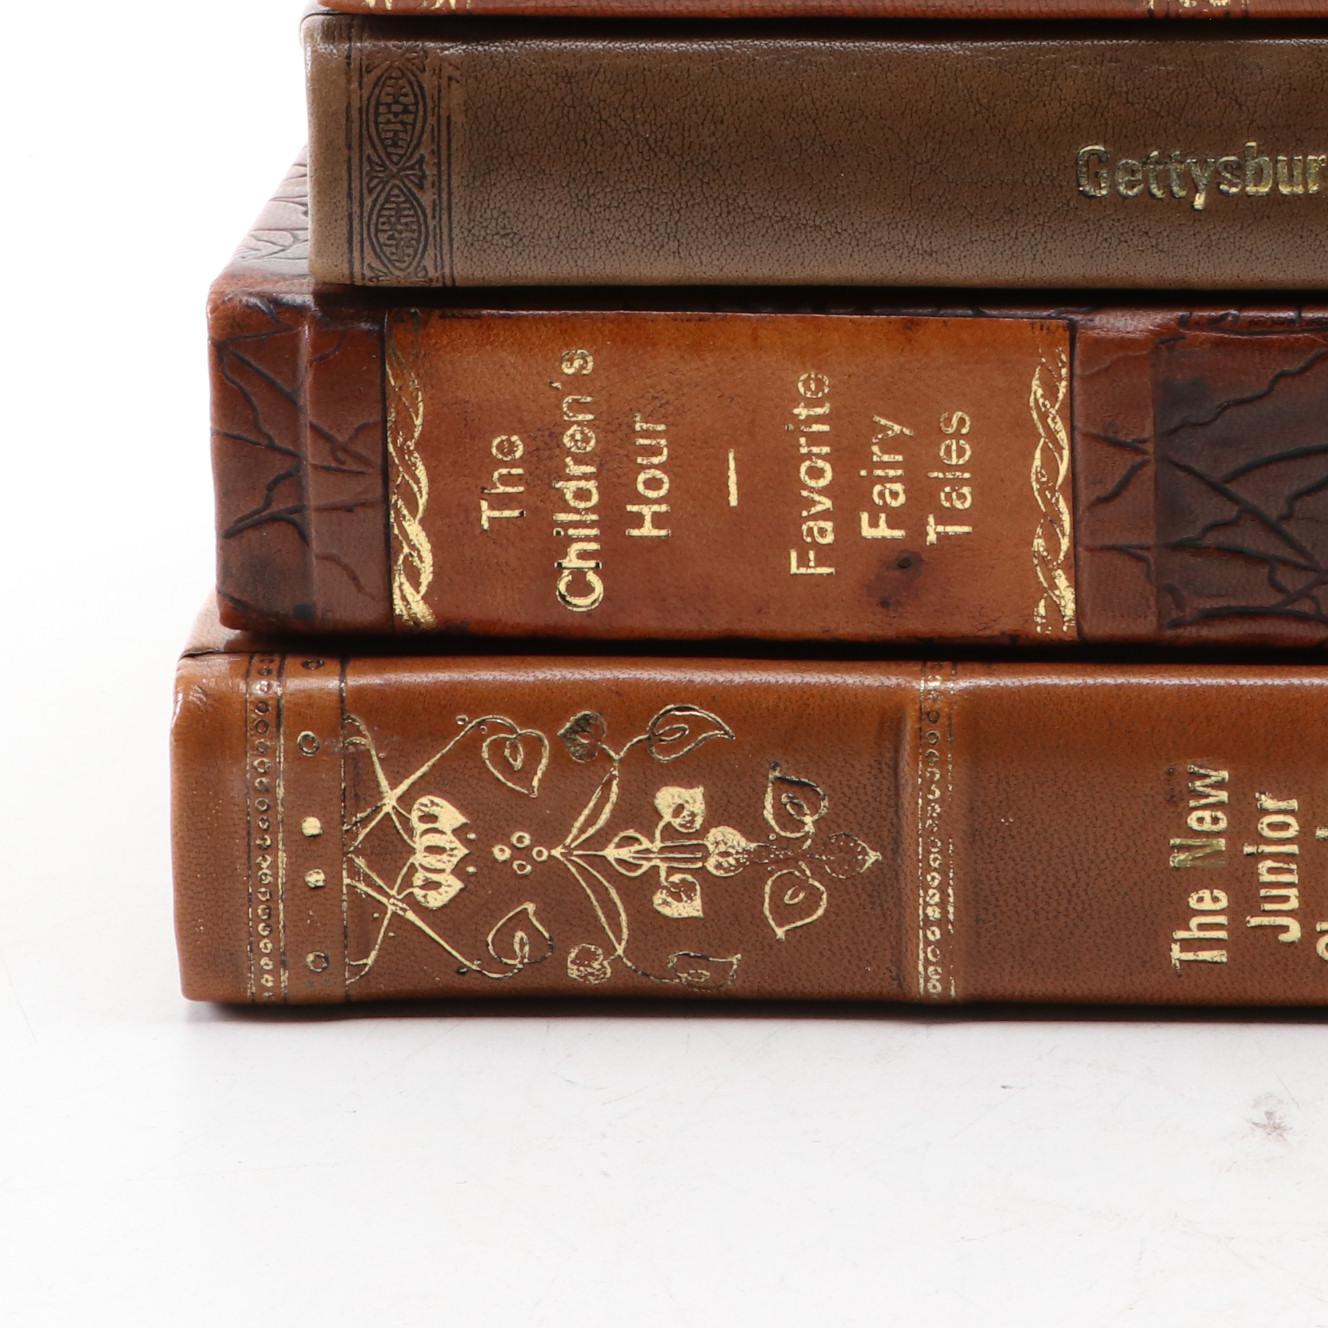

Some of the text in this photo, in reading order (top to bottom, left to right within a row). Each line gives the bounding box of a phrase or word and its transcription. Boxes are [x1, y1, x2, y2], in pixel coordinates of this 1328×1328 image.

[480, 434, 526, 532] The
[548, 348, 605, 612] Children's
[626, 413, 671, 538] Hour
[785, 371, 836, 577] Favorite
[860, 414, 914, 540] Fairy
[927, 410, 973, 546] Tales
[1169, 764, 1230, 970] The New
[1243, 790, 1301, 943] Junior
